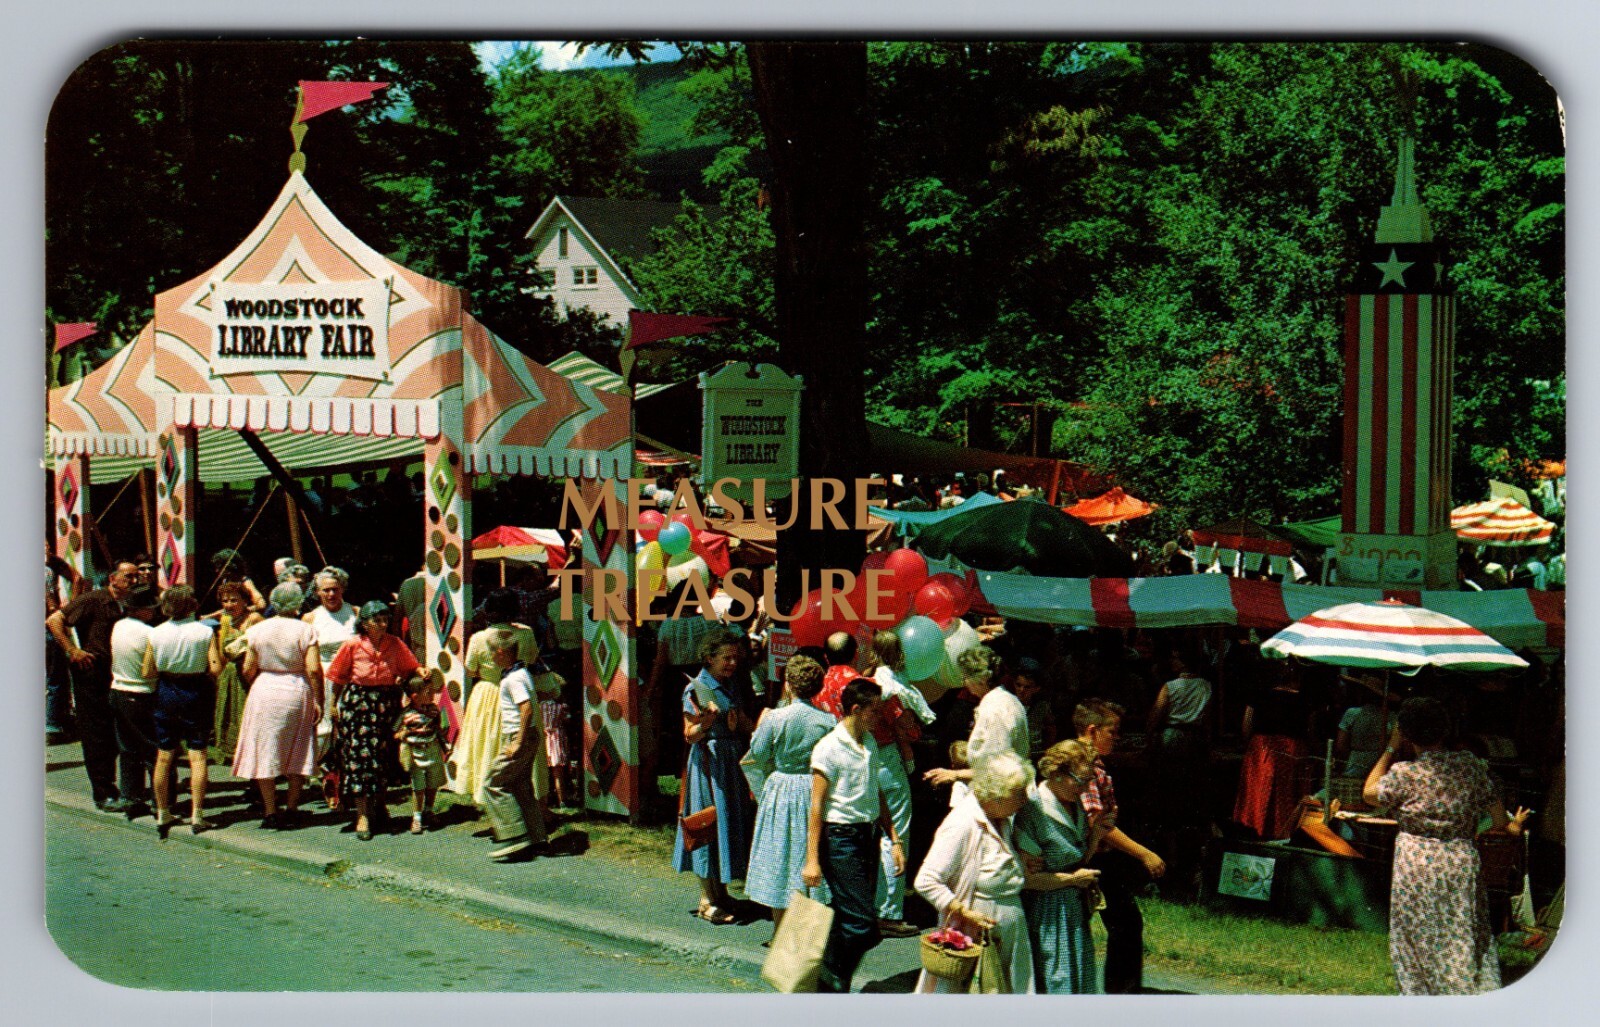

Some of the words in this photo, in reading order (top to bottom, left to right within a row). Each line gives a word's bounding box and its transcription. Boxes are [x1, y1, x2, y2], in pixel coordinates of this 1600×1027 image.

[225, 298, 365, 319] WOODSTOCK
[218, 324, 312, 359] LIBRARY
[320, 324, 376, 359] FAIR
[721, 415, 787, 435] WOODSTOCK
[726, 443, 781, 464] LIBRARY
